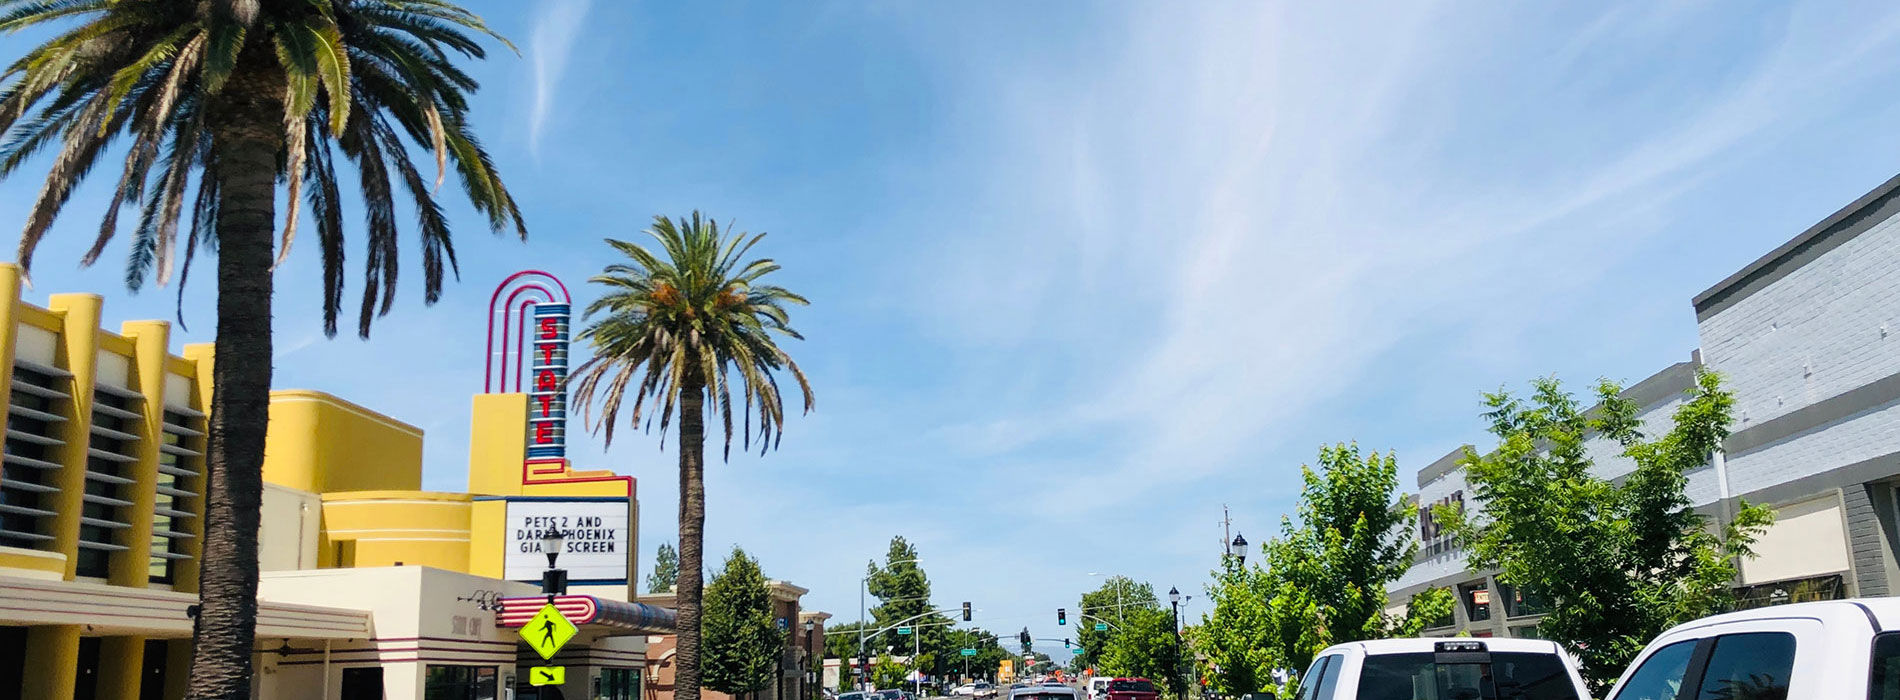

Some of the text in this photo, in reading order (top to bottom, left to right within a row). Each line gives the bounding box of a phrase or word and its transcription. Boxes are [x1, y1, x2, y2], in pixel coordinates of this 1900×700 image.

[536, 318, 558, 443] STATE
[525, 516, 602, 527] PETS 2 AND
[562, 529, 615, 540] PHOENIX
[567, 541, 615, 553] SCREEN
